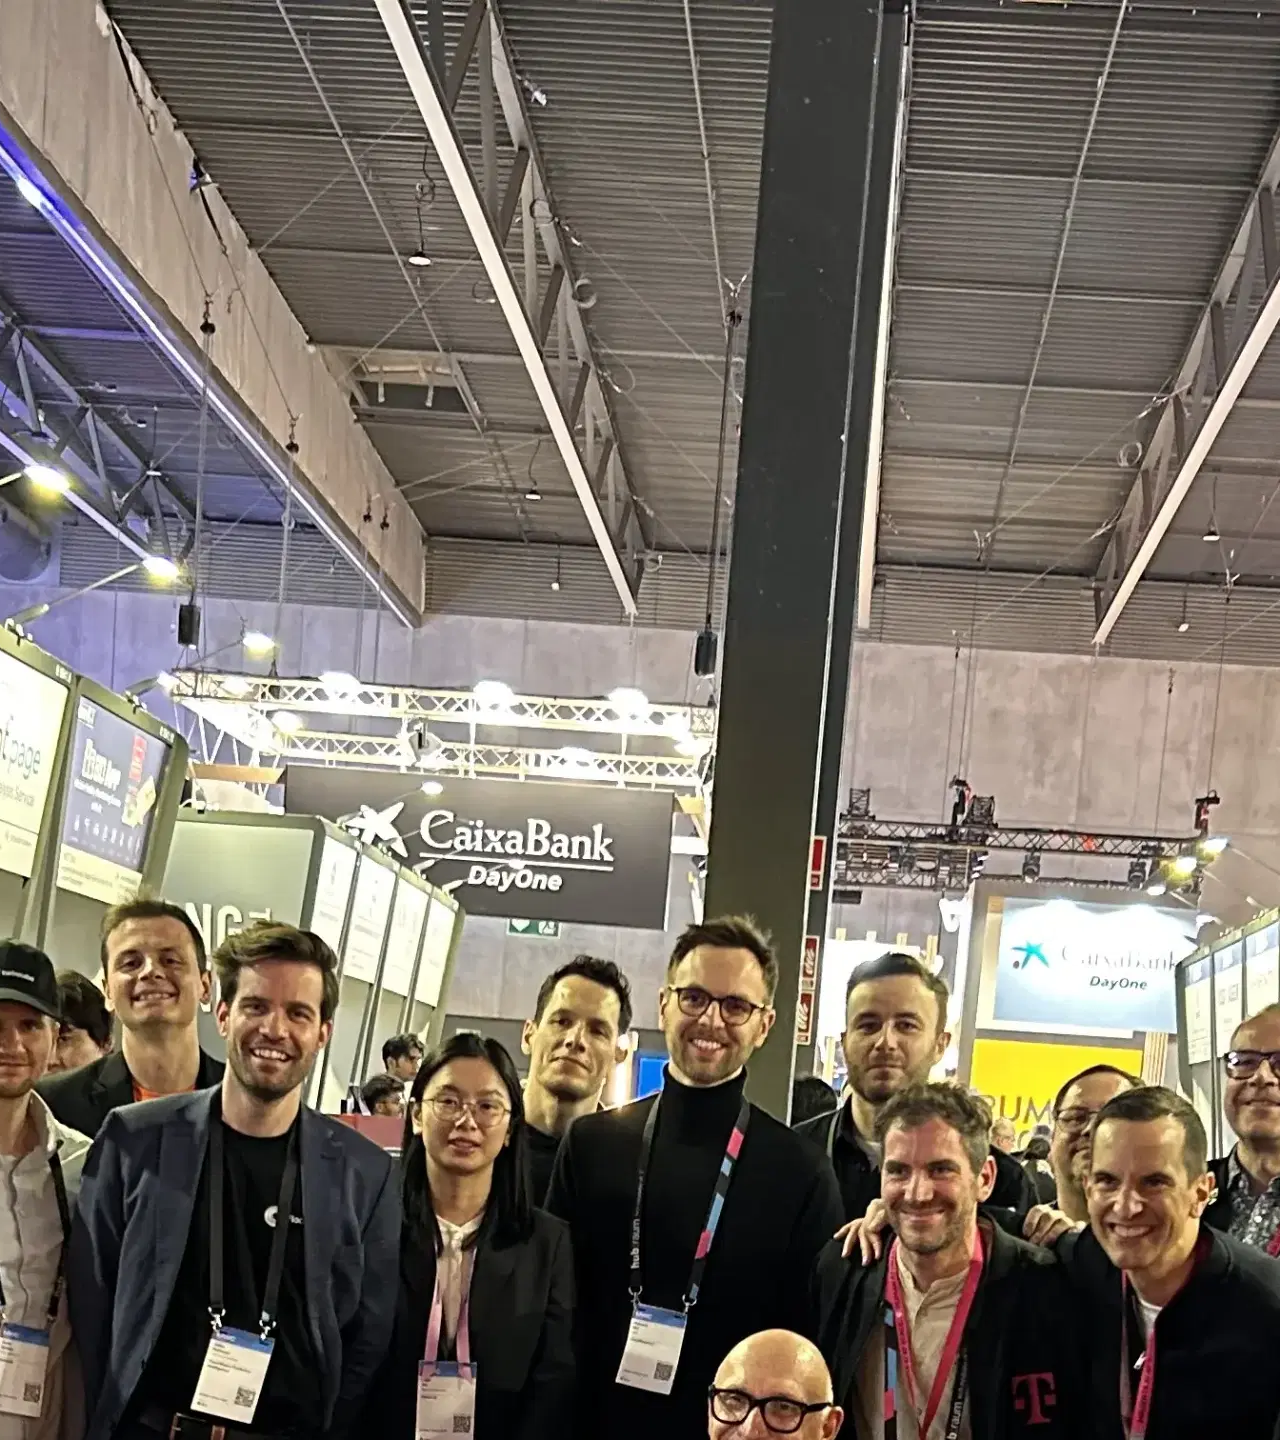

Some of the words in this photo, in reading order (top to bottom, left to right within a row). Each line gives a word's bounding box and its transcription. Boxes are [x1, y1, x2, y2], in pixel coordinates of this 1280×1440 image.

[420, 809, 614, 862] CaixaBank
[467, 865, 563, 893] DayOne
[1089, 976, 1148, 990] DayOne
[1011, 1371, 1056, 1425] T
